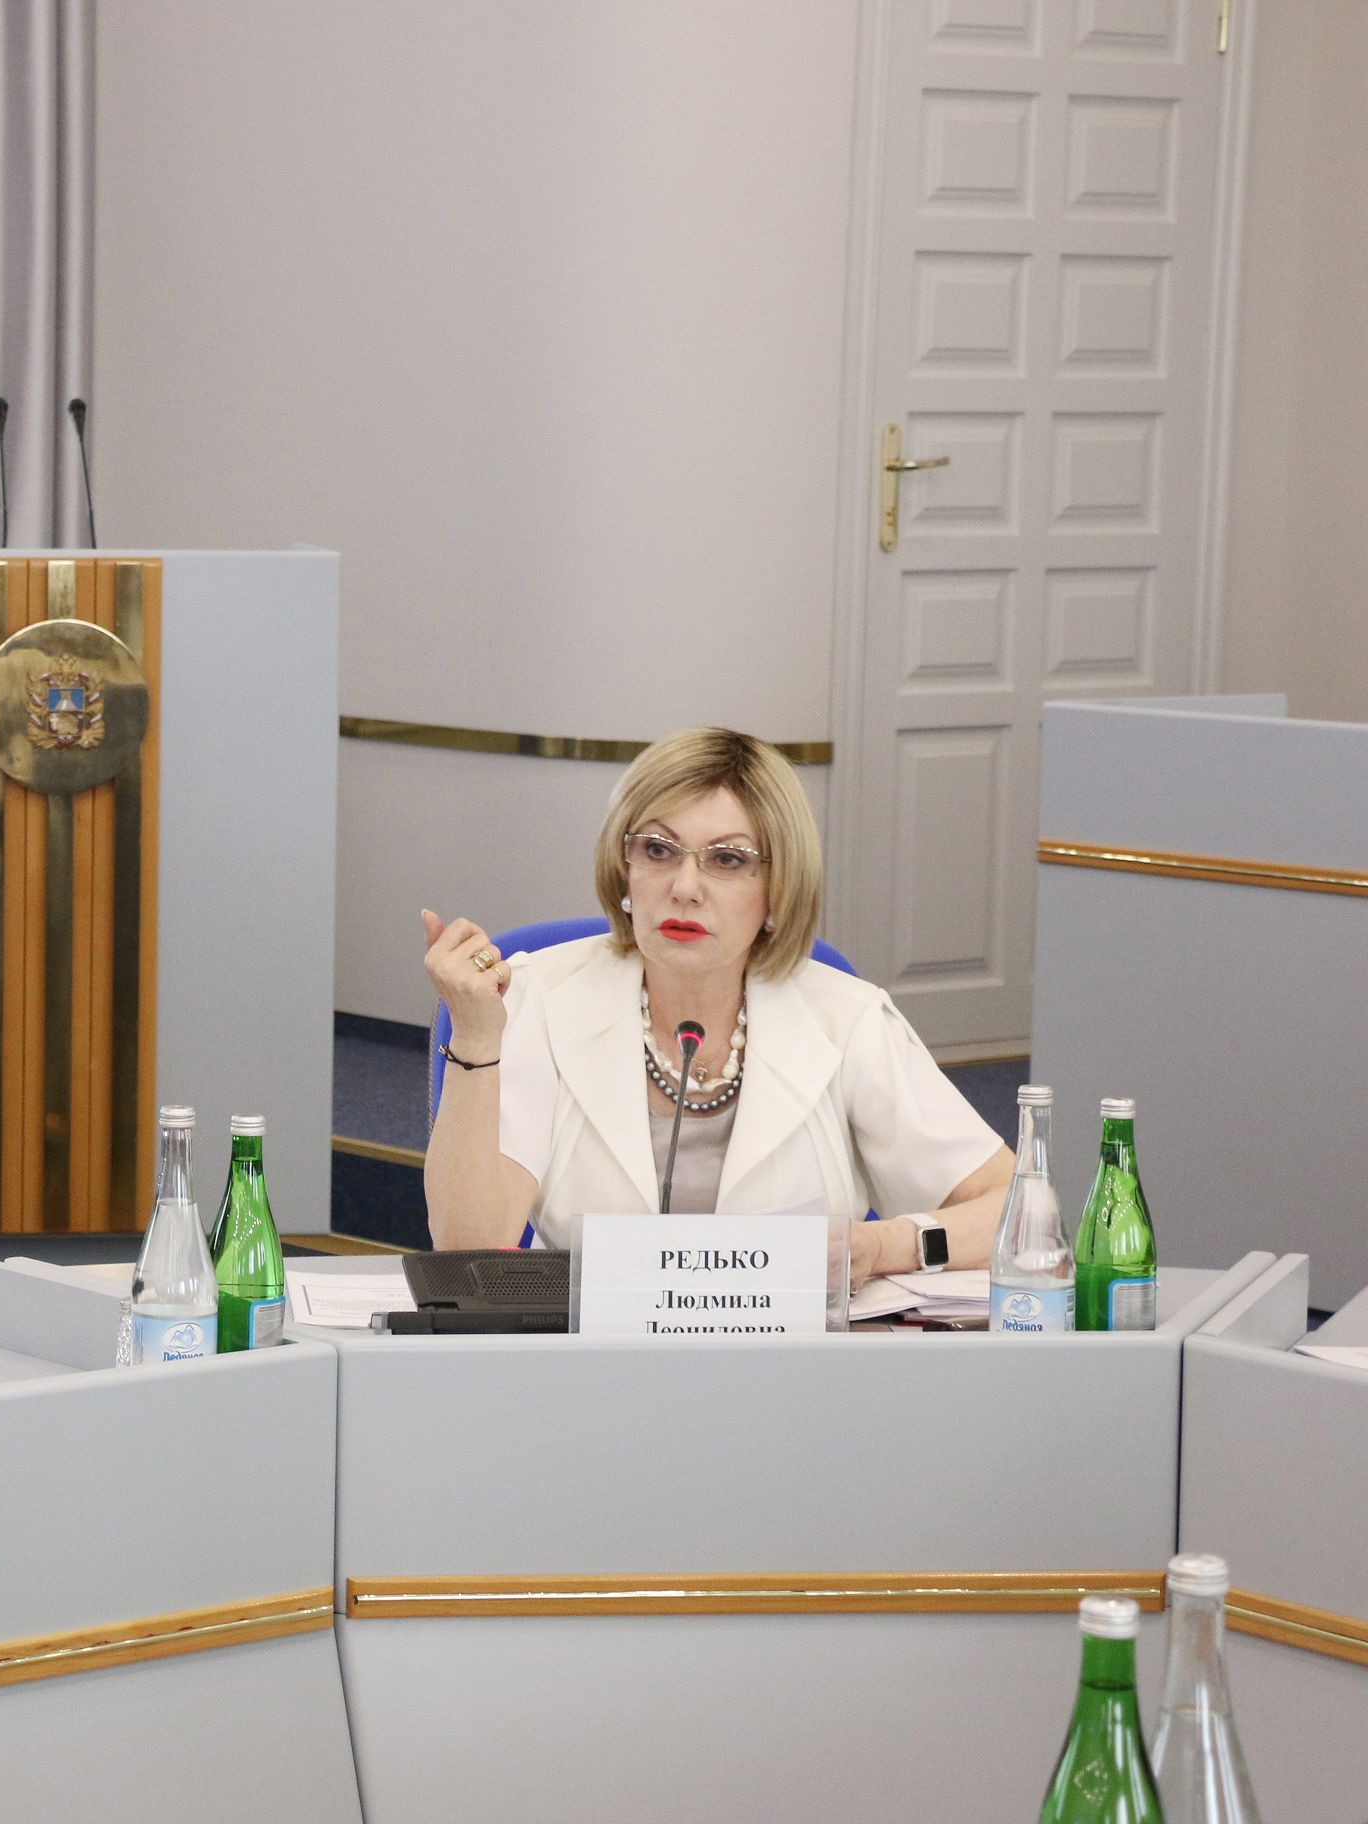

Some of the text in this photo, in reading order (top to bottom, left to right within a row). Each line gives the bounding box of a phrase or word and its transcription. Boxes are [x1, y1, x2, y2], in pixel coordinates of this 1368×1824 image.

[659, 1250, 769, 1272] РЕДЬКО
[656, 1290, 772, 1310] Людмила
[522, 1314, 564, 1325] PHILIPS
